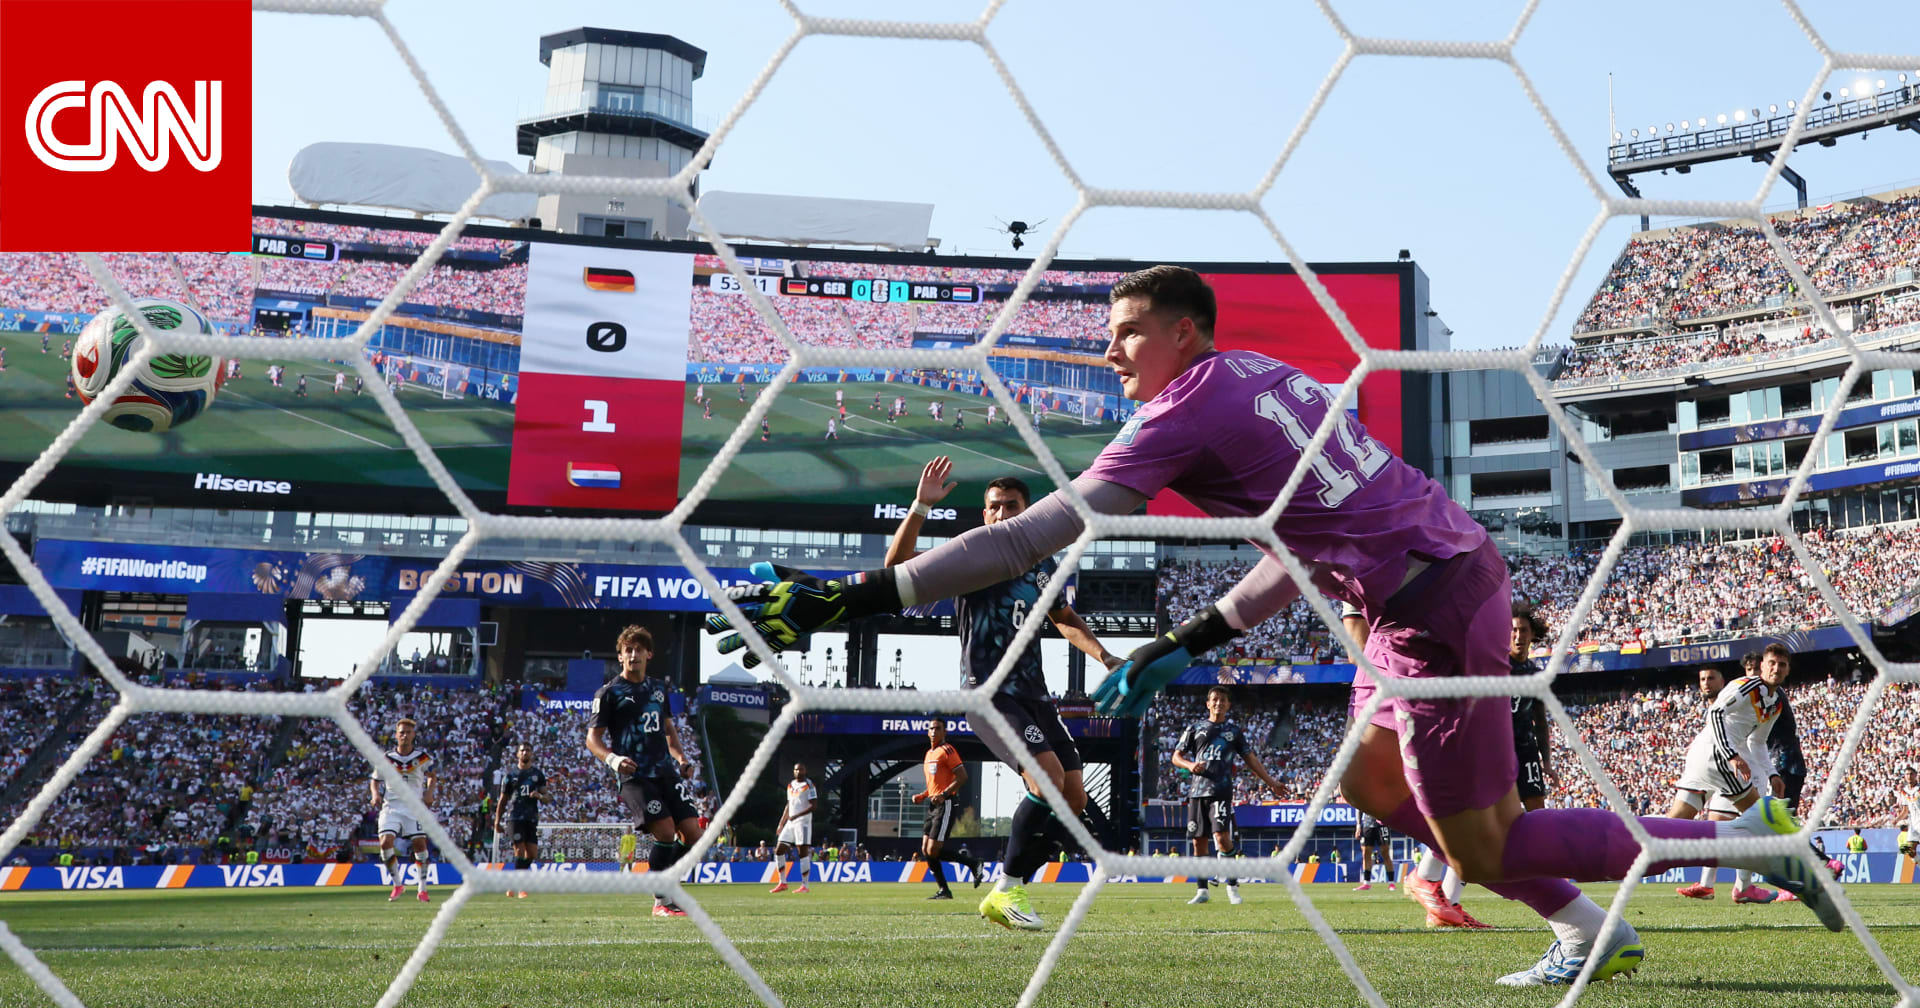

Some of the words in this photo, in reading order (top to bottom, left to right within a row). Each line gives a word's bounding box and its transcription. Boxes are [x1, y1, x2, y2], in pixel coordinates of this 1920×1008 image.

[258, 238, 287, 254] PAR
[823, 282, 847, 296] GER
[857, 284, 865, 297] 0
[895, 286, 903, 298] 1
[913, 285, 938, 300] PAR
[0, 320, 20, 331] ISA
[696, 373, 721, 383] VISA
[807, 373, 828, 382] VISA
[582, 399, 616, 433] 1
[1254, 373, 1393, 508] 12
[194, 473, 292, 495] Hisense
[874, 503, 957, 520] Hisse
[81, 557, 207, 583] #FIFAWorldCup
[595, 576, 652, 598] FIFA
[1012, 599, 1026, 630] 6
[1670, 644, 1730, 663] BOSTON
[711, 691, 765, 705] BOSTON
[642, 711, 660, 733] 23
[882, 719, 908, 731] FIFA
[1207, 743, 1221, 760] 14
[1525, 761, 1540, 783] 13
[520, 785, 530, 796] 21
[1214, 801, 1227, 818] 14
[1271, 808, 1305, 823] FIFA
[266, 847, 291, 859] BAD
[55, 866, 124, 889] VISA
[220, 865, 284, 887] VISA
[813, 862, 872, 882] VISA
